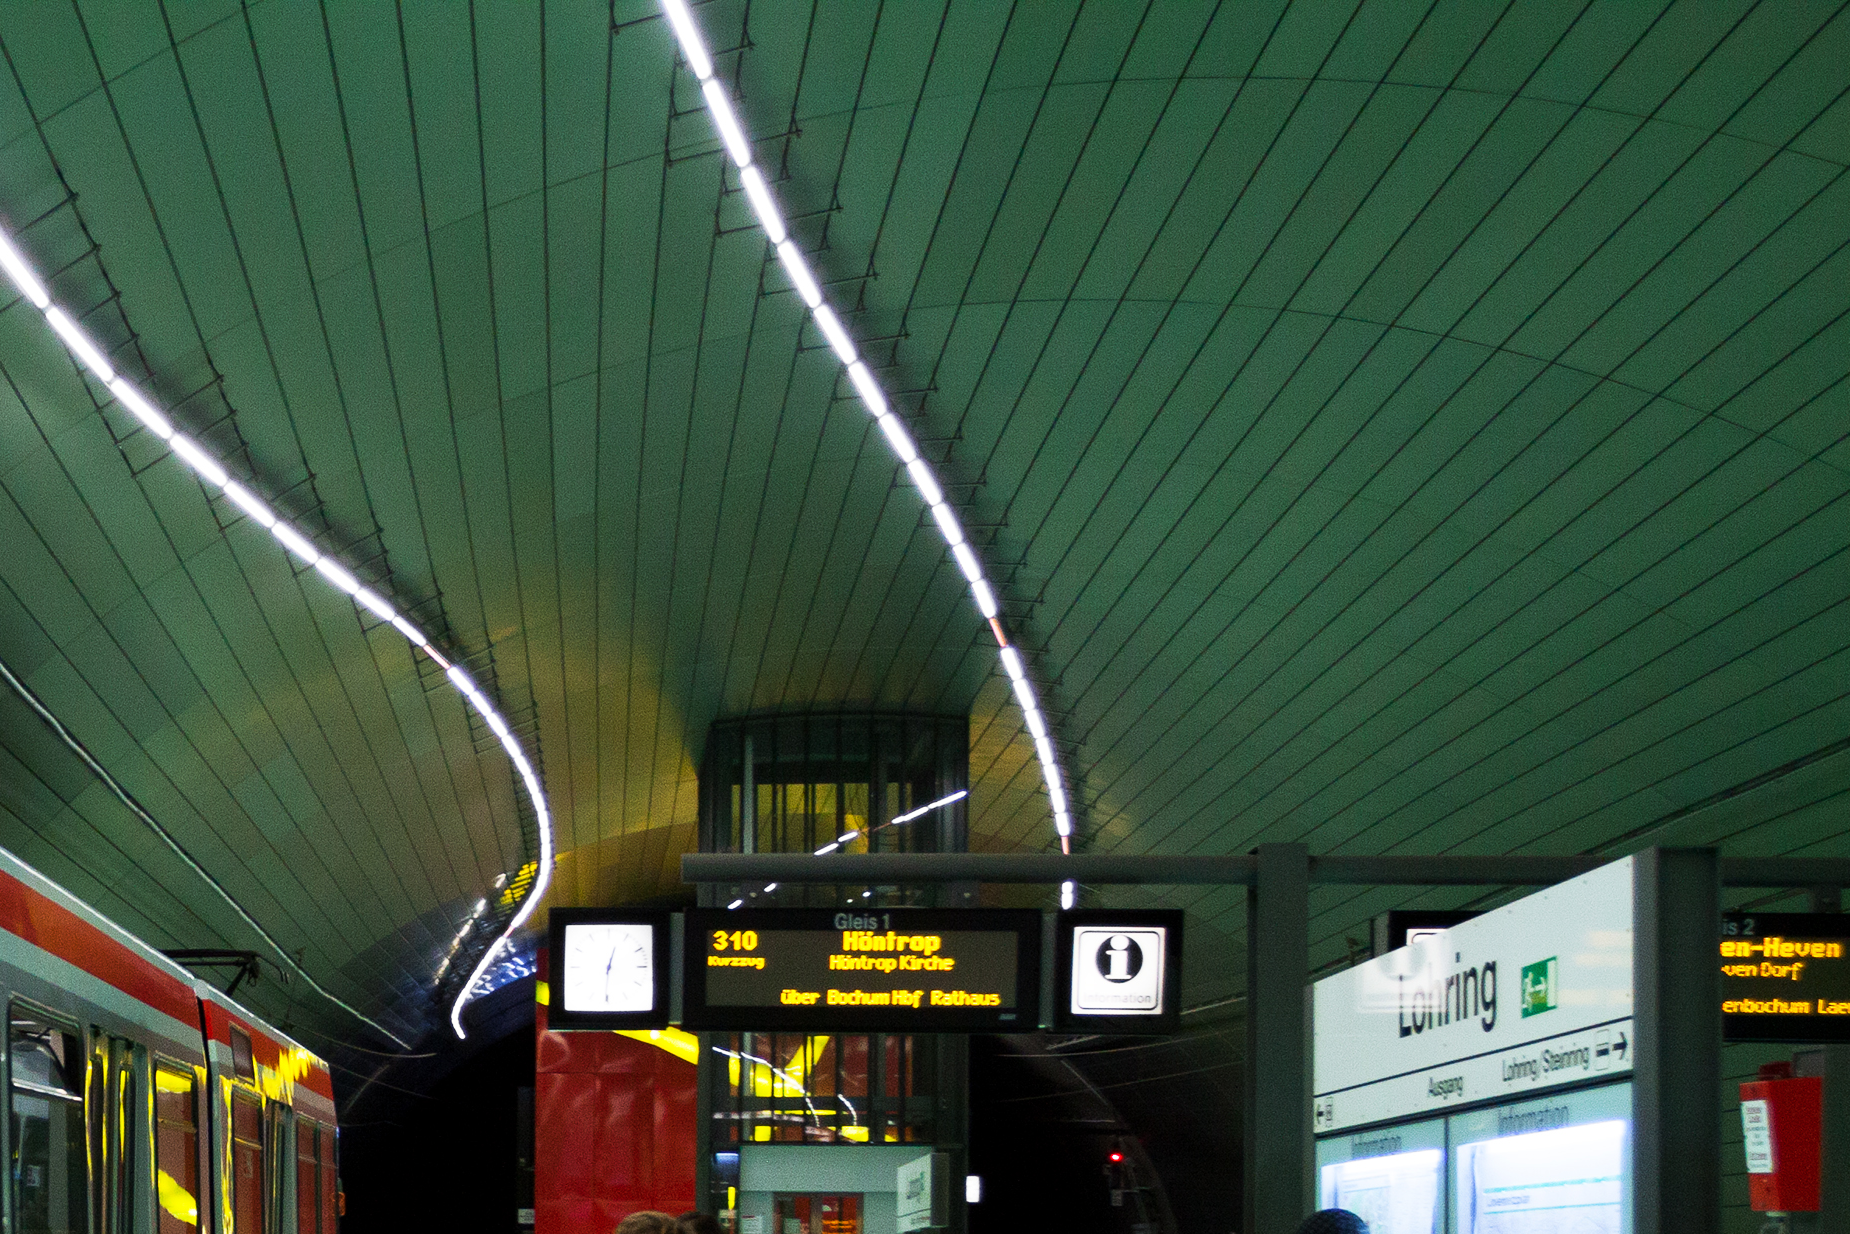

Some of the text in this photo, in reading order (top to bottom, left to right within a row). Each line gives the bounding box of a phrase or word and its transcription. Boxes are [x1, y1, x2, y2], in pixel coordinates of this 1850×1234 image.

[834, 912, 891, 930] Gleis 1
[1742, 918, 1755, 936] 2
[712, 930, 758, 951] 310
[842, 930, 942, 956] Höntrop
[1720, 937, 1841, 958] en-Heven
[707, 955, 766, 970] Kurzzug
[829, 954, 956, 974] Höntrop Kirche
[1721, 961, 1804, 981] ven Dorf
[780, 988, 1002, 1009] über Bochum Hbf Rathaus
[1398, 950, 1497, 1039] Lohring
[1721, 998, 1811, 1014] enbochum
[1428, 1075, 1463, 1100] Ausgang
[1497, 1104, 1569, 1135] Information
